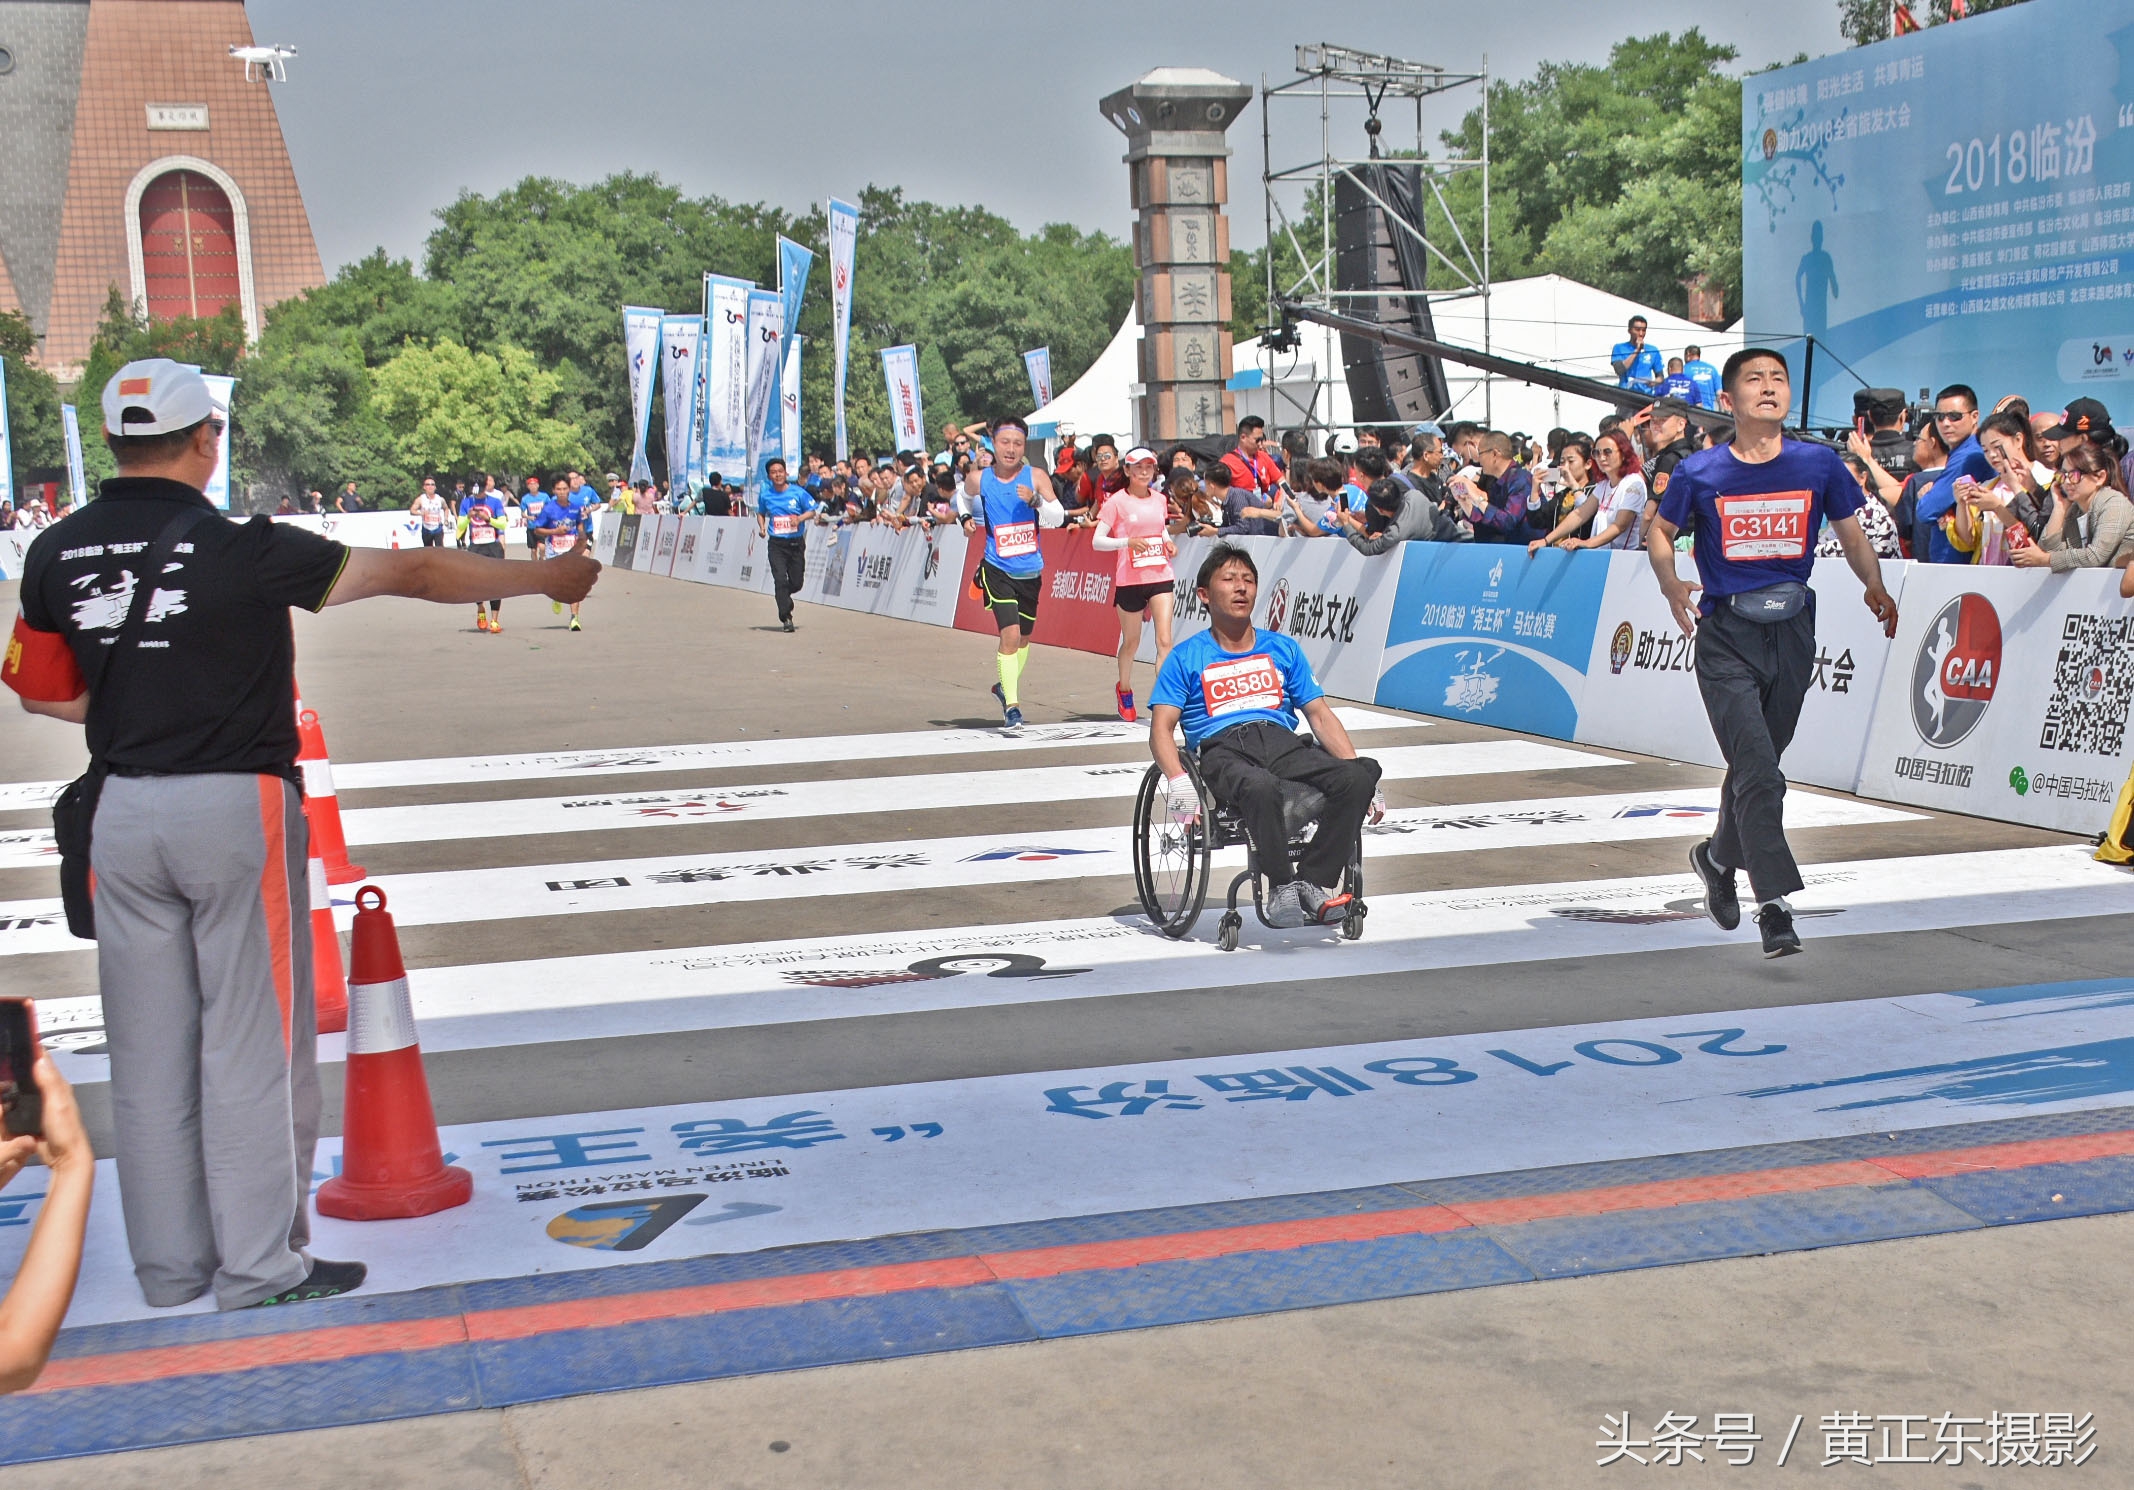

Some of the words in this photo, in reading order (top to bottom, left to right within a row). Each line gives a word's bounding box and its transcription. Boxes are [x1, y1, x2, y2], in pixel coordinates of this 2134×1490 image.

[1817, 70, 1864, 101] 阳光生活
[1777, 102, 1911, 153] 助力2018全省旅发大会
[1945, 114, 2096, 195] 2018临汾
[999, 530, 1034, 547] C4002
[1729, 514, 1797, 538] C3141
[1050, 569, 1111, 604] 尧都区人民政府
[1289, 591, 1359, 644] 临汾文化
[1421, 603, 1466, 630] 2018临汾
[1470, 606, 1511, 633] “尧王杯”
[1512, 611, 1557, 639] 马拉松赛
[1211, 671, 1273, 700] C3580
[1945, 656, 1993, 688] CAA
[1895, 756, 1974, 789] 中国马拉松
[2032, 773, 2114, 803] @中国马拉松
[545, 857, 932, 892] 兴业集团
[1042, 1026, 1788, 1121] 2018临汾
[516, 1168, 677, 1191] MARATHON
[688, 1158, 784, 1174] LINFEN
[517, 1166, 792, 1202] 临汾马拉松赛
